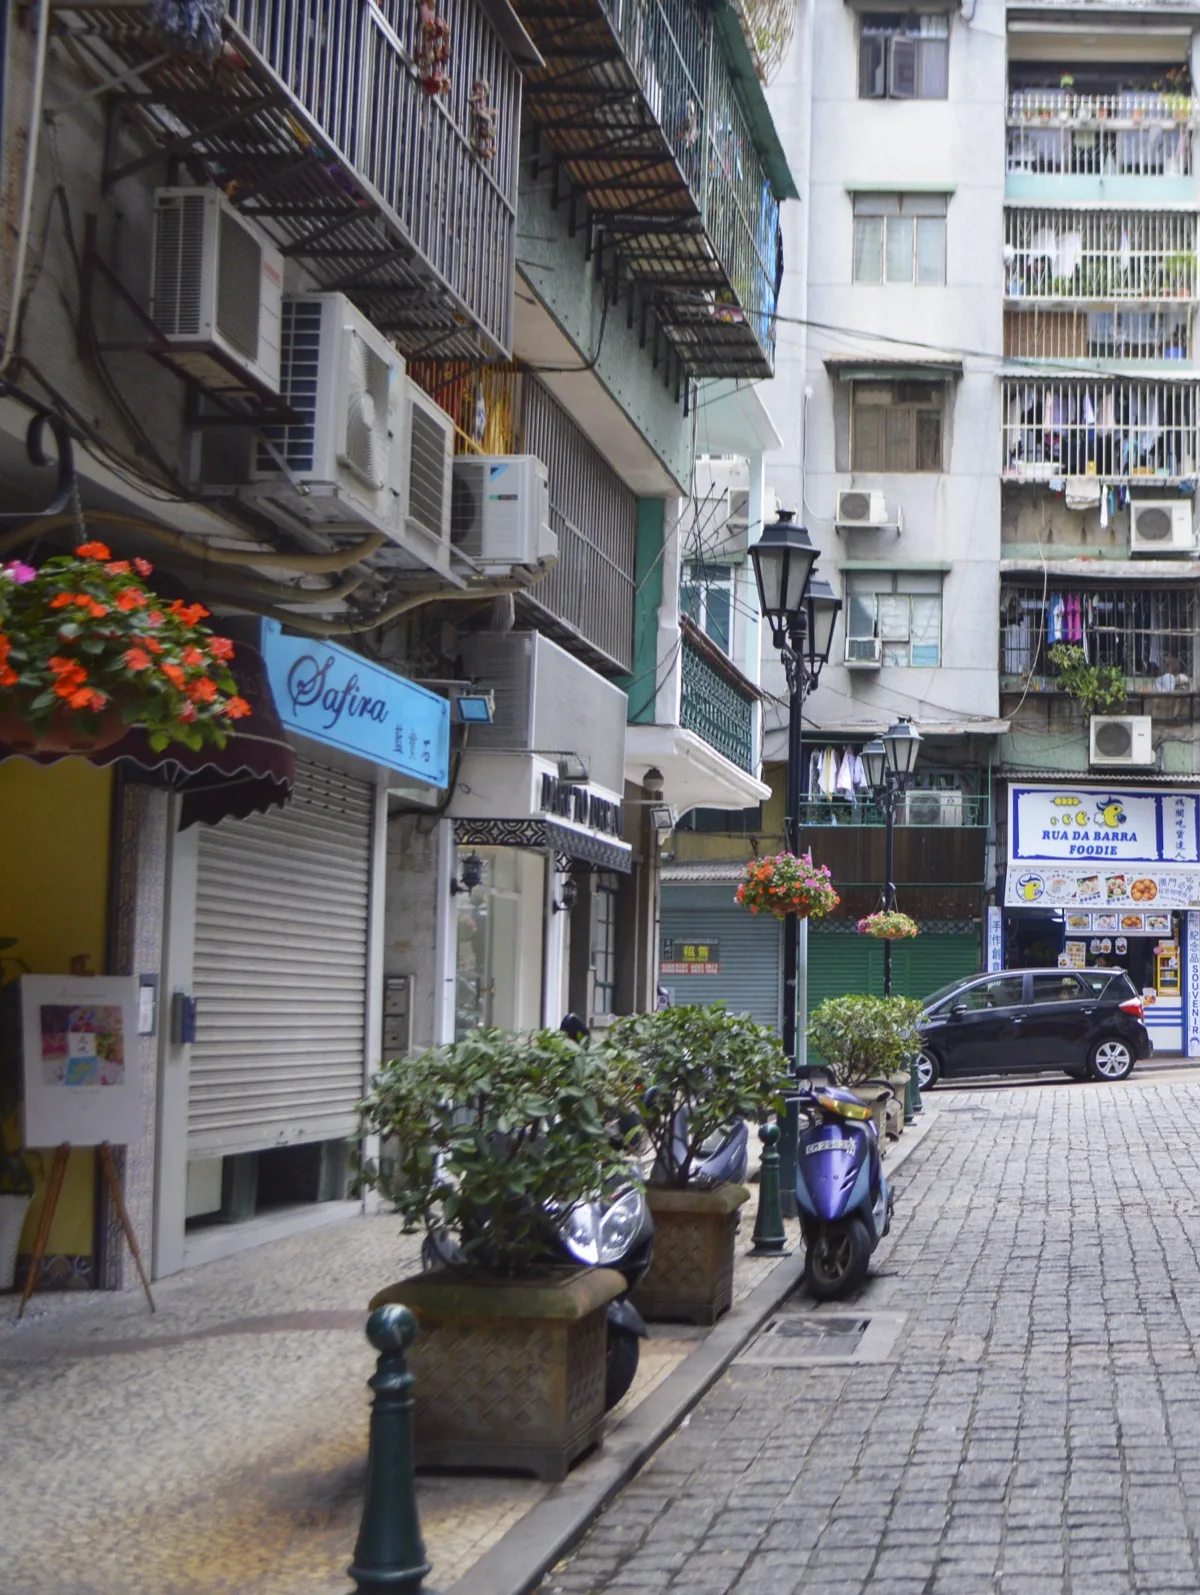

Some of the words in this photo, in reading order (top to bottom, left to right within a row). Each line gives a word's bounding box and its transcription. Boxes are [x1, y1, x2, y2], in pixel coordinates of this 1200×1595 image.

[287, 654, 389, 729] Safira
[1042, 830, 1069, 841] RUA
[1072, 831, 1090, 841] DA
[1093, 831, 1138, 842] BARRA
[1069, 844, 1118, 855] FOODIE
[1192, 964, 1200, 1034] SOUVENIR
